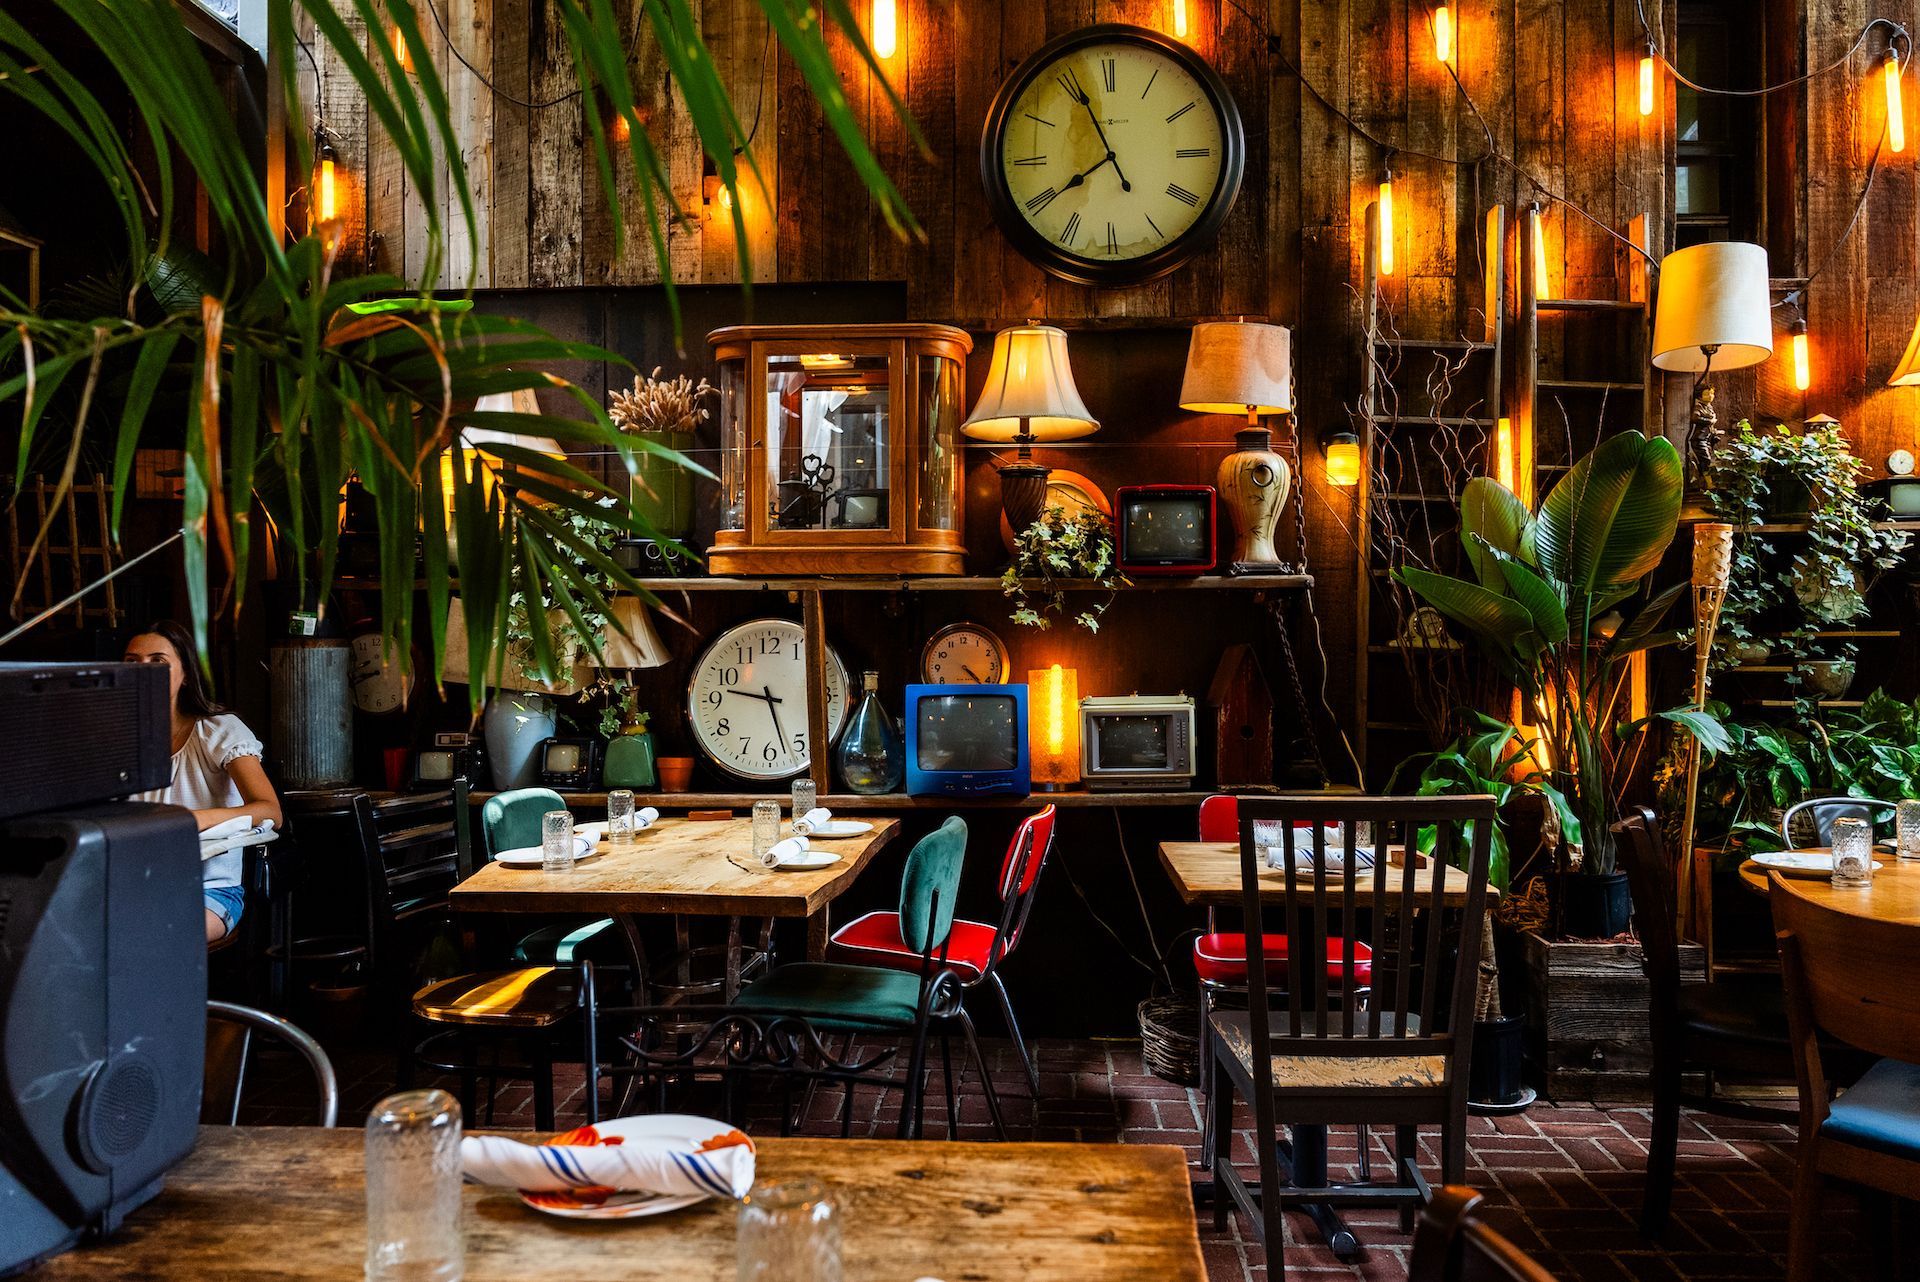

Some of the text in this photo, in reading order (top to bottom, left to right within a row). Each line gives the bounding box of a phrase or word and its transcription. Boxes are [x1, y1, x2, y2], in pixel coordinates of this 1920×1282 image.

[759, 637, 781, 655] 12
[948, 641, 954, 649] 11
[959, 636, 967, 645] 12
[736, 647, 755, 665] 11
[793, 643, 801, 660] 1
[938, 651, 948, 659] 10
[985, 649, 991, 657] 2
[934, 664, 941, 673] 9
[990, 662, 995, 671] 3
[718, 667, 739, 686] 10
[708, 690, 722, 712] 9
[716, 717, 730, 736] 8
[739, 736, 752, 755] 7
[763, 741, 777, 761] 6
[793, 733, 806, 753] 5
